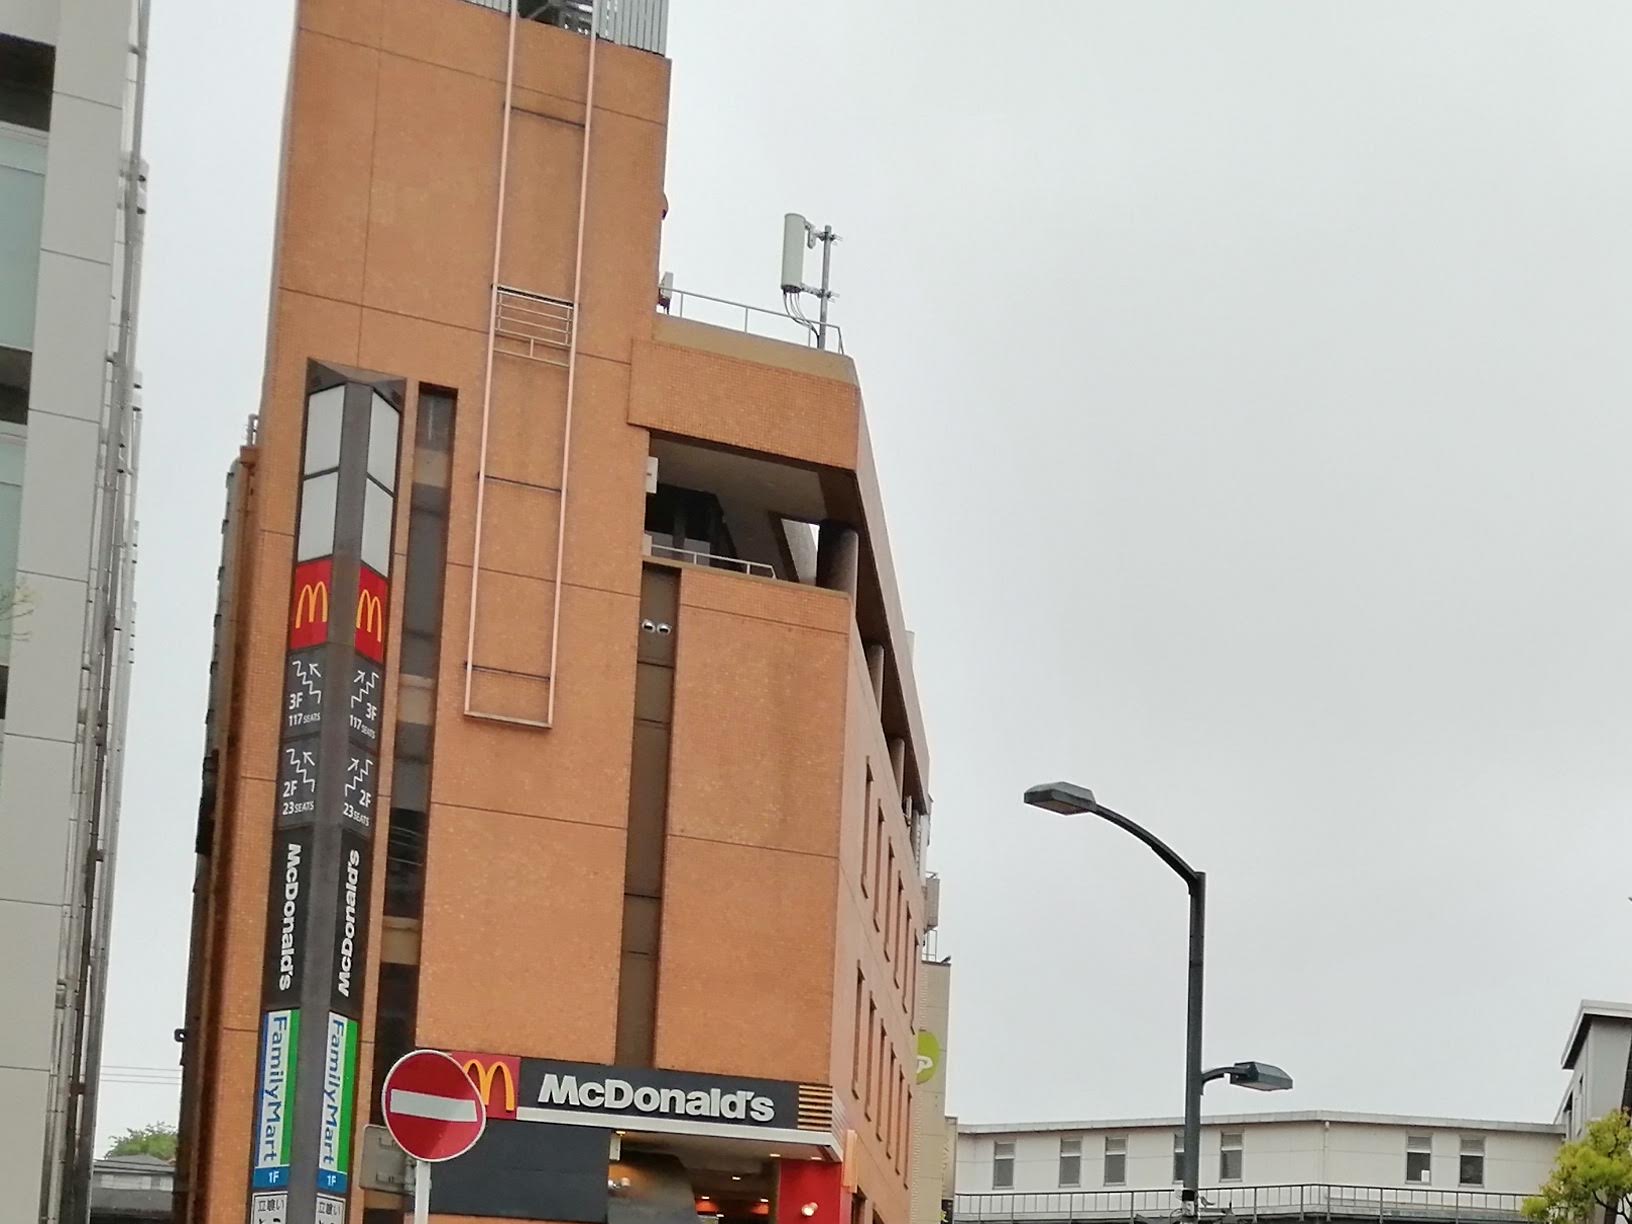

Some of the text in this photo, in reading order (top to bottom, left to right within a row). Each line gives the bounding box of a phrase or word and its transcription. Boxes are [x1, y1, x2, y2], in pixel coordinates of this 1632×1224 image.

[289, 692, 303, 710] 3F
[289, 712, 321, 727] 117 SEATS
[365, 702, 377, 720] 3F
[350, 714, 362, 730] 117
[283, 780, 298, 797] 2F
[359, 789, 372, 808] 2F
[282, 801, 315, 816] 23 SEATS
[343, 802, 370, 826] 23 SEATS
[279, 843, 302, 991] McDonald's
[337, 849, 360, 998] McDonald's
[263, 1015, 288, 1162] FamilyMart
[322, 1019, 345, 1165] FamilyMart
[537, 1073, 776, 1122] McDonald's
[268, 1171, 280, 1184] 1F
[326, 1175, 337, 1187] 1F
